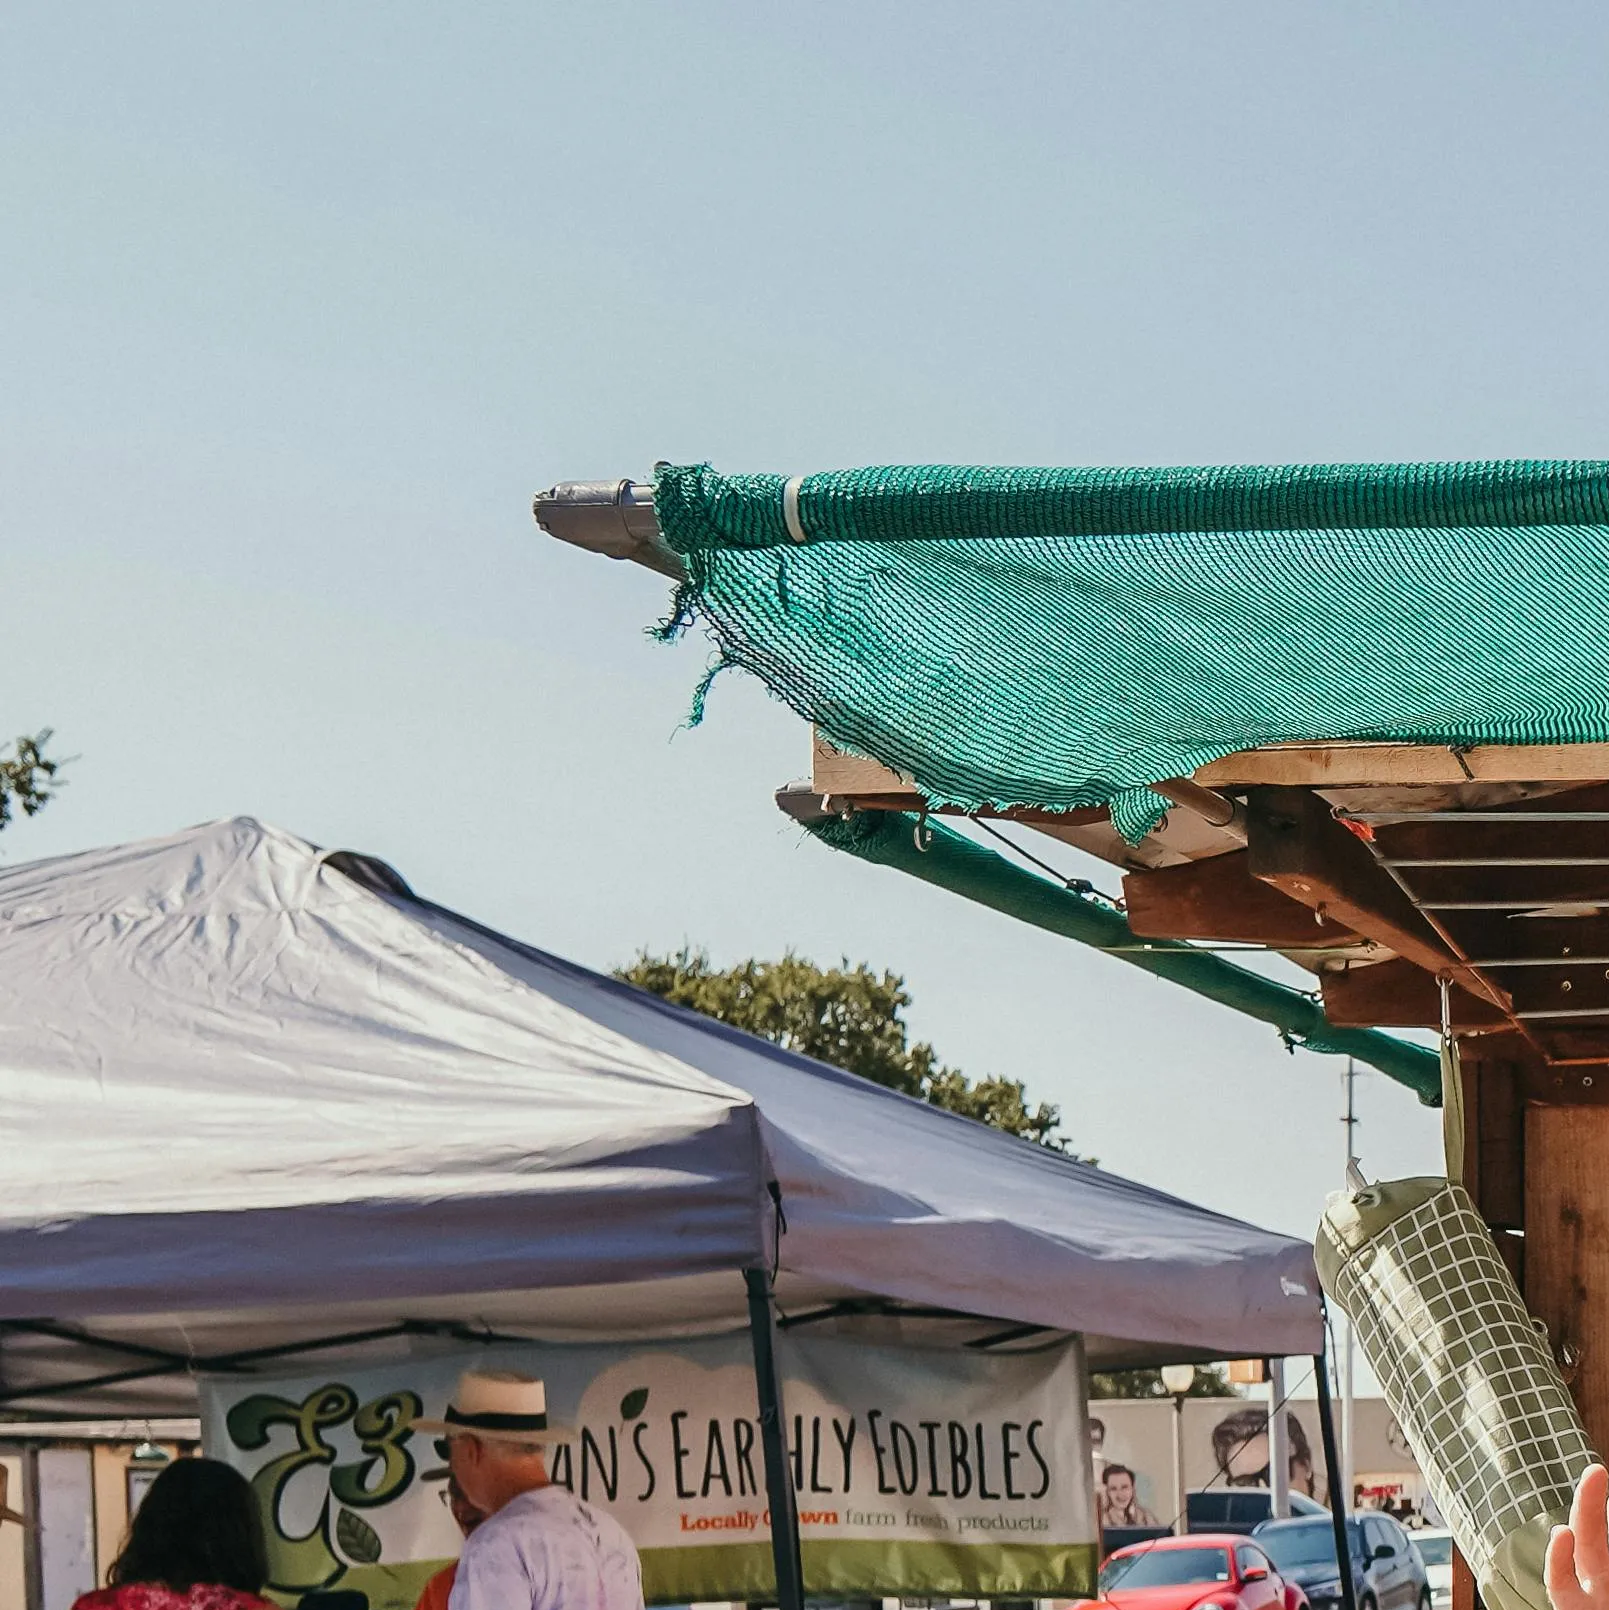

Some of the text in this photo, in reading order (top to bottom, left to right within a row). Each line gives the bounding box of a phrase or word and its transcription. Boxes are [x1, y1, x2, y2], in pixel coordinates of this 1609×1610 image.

[670, 1410, 857, 1500] EARHLY
[870, 1408, 1050, 1500] EDIBLES
[679, 1511, 760, 1532] Locally
[845, 1508, 897, 1527] farm
[904, 1508, 949, 1528] fresh
[957, 1512, 1050, 1533] products
